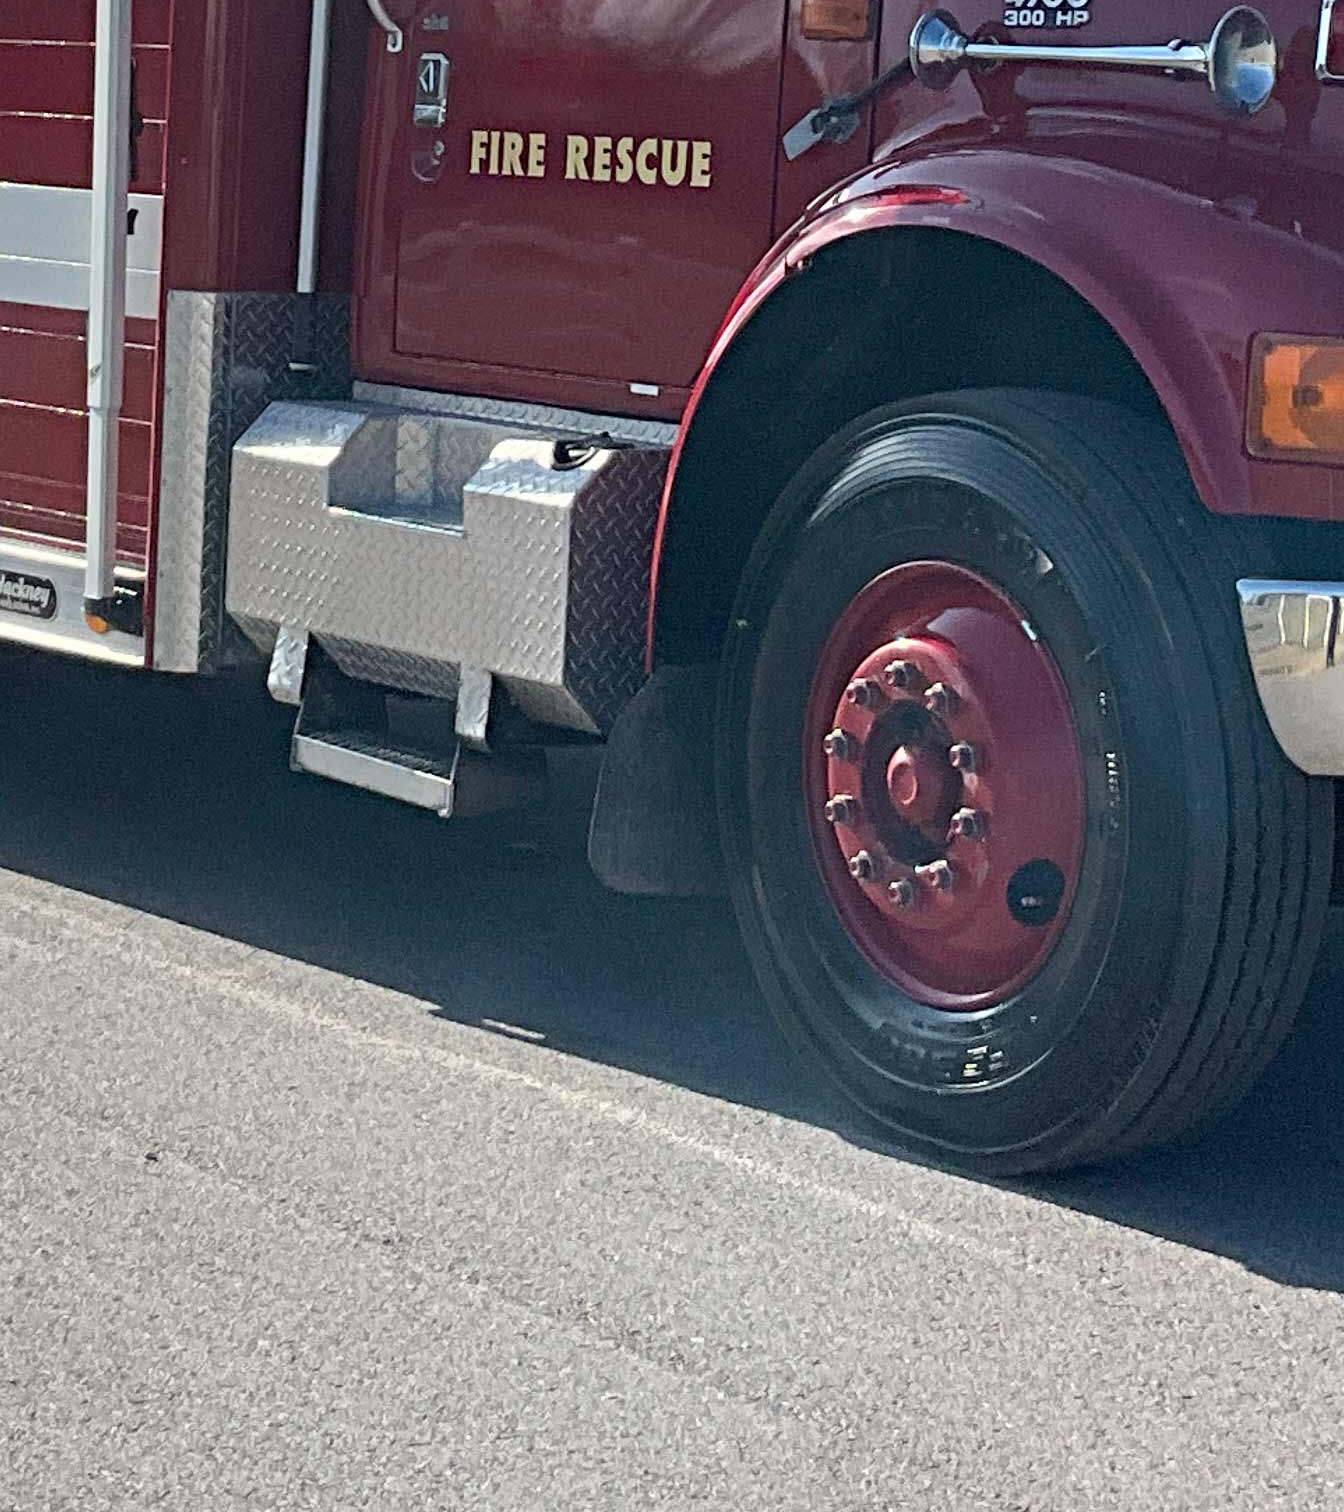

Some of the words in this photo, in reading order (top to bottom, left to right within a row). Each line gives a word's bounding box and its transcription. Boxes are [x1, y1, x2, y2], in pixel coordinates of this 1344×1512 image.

[1003, 9, 1045, 26] 300
[1056, 10, 1089, 26] HP
[469, 130, 546, 177] FIRE
[564, 135, 712, 187] RESCUE
